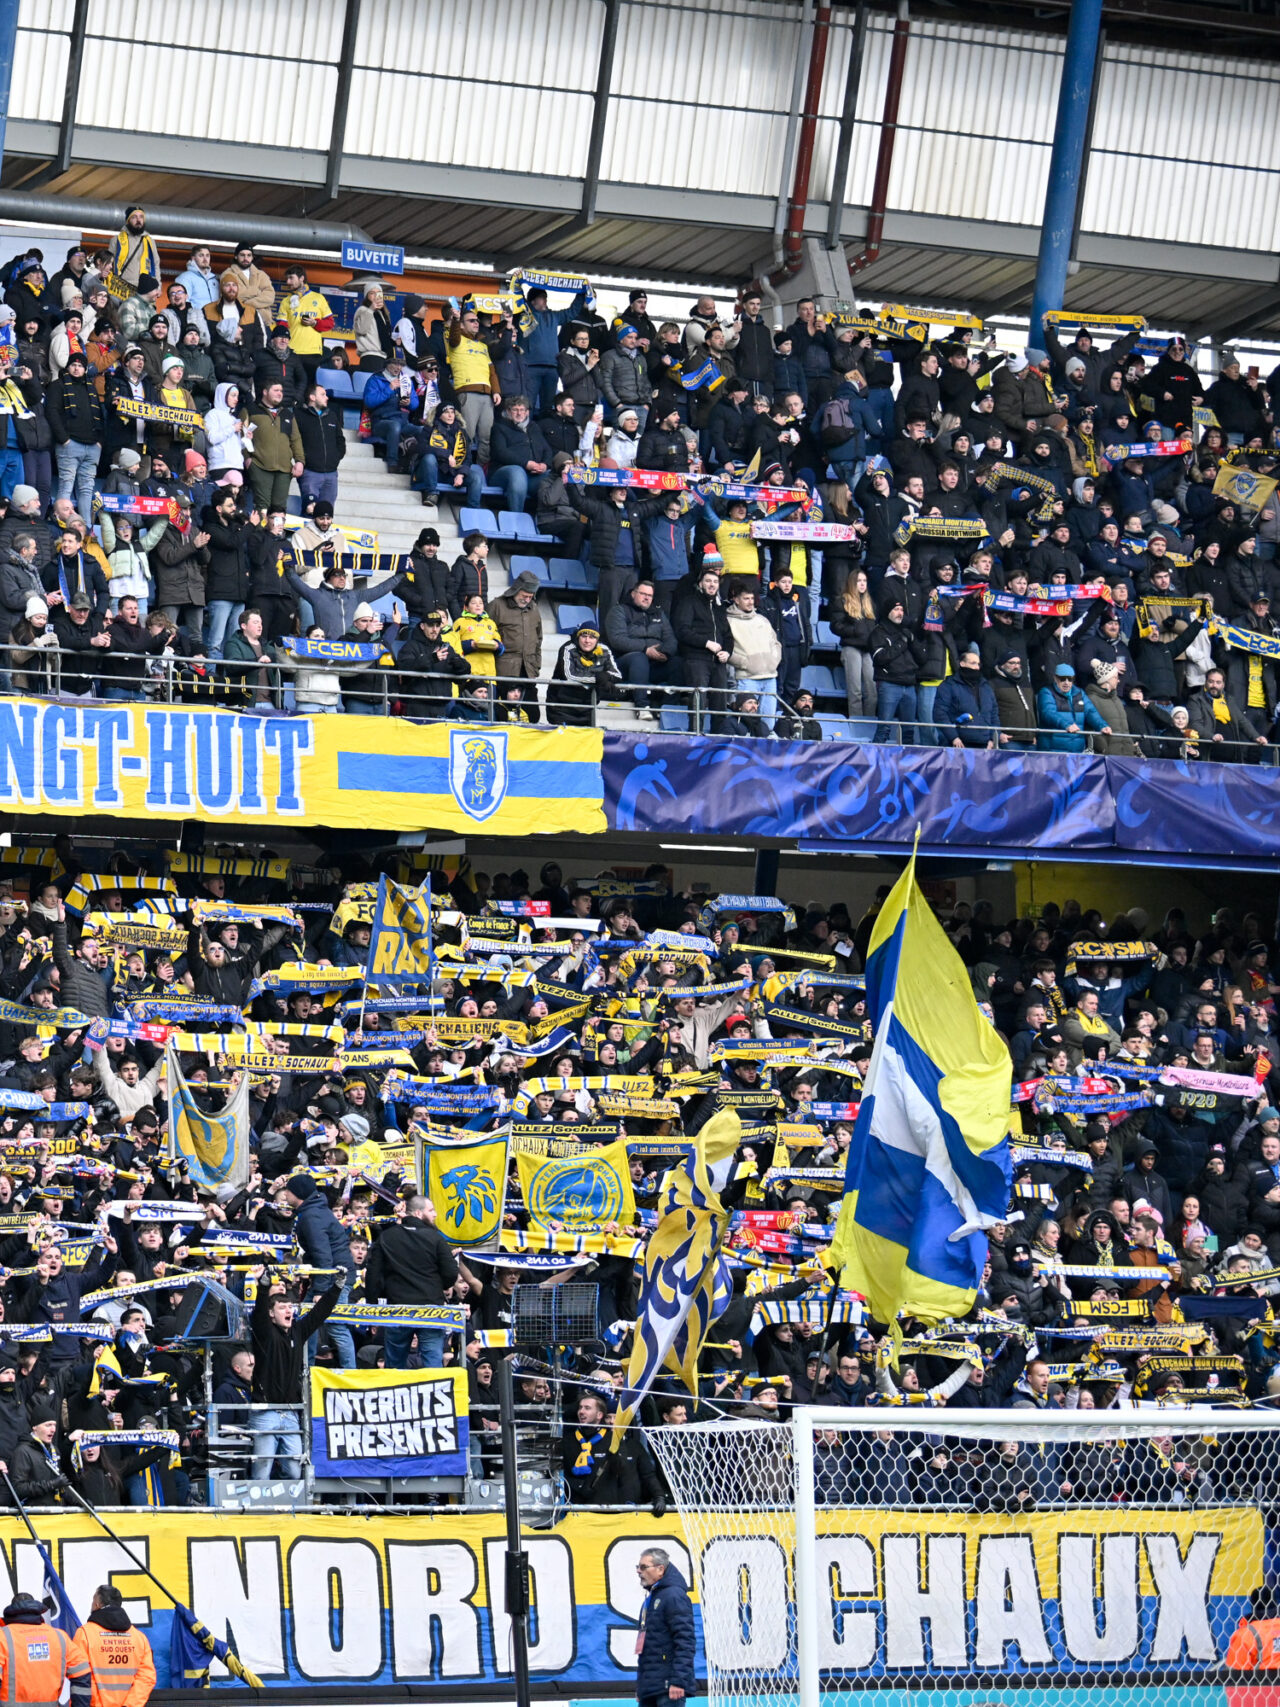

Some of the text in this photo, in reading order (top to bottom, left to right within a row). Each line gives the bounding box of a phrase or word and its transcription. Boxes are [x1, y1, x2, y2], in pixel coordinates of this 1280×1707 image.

[346, 247, 400, 267] BUVETTE
[548, 276, 584, 289] SOCHAUX
[120, 397, 194, 424] ALLEZ SOCHAUX
[946, 529, 982, 539] DORTMUND
[307, 639, 362, 658] FCSM
[468, 919, 510, 931] Coupe de France
[373, 930, 430, 976] RAS
[657, 952, 698, 965] SOCHAUX
[430, 1021, 501, 1035] SOCHALIENS
[767, 1007, 860, 1037] ALLEZ Sochaux
[240, 1054, 331, 1070] ALLEZ SOCHAUX
[355, 1053, 370, 1063] ANS
[1179, 1091, 1218, 1109] 1928
[554, 1124, 617, 1134] Sochaux
[1046, 1264, 1163, 1279] TRIBUNE NORD
[1144, 1335, 1186, 1348] SOCHAUX
[1160, 1357, 1200, 1368] SOCHAUX
[326, 1380, 453, 1424] INTERDITS
[328, 1416, 458, 1459] PRESENTS
[185, 1532, 577, 1685] NORD
[604, 1530, 1227, 1682] SOCHAUX
[100, 1646, 117, 1654] SUD
[104, 1639, 132, 1647] ENTRÉE
[108, 1654, 129, 1666] 200
